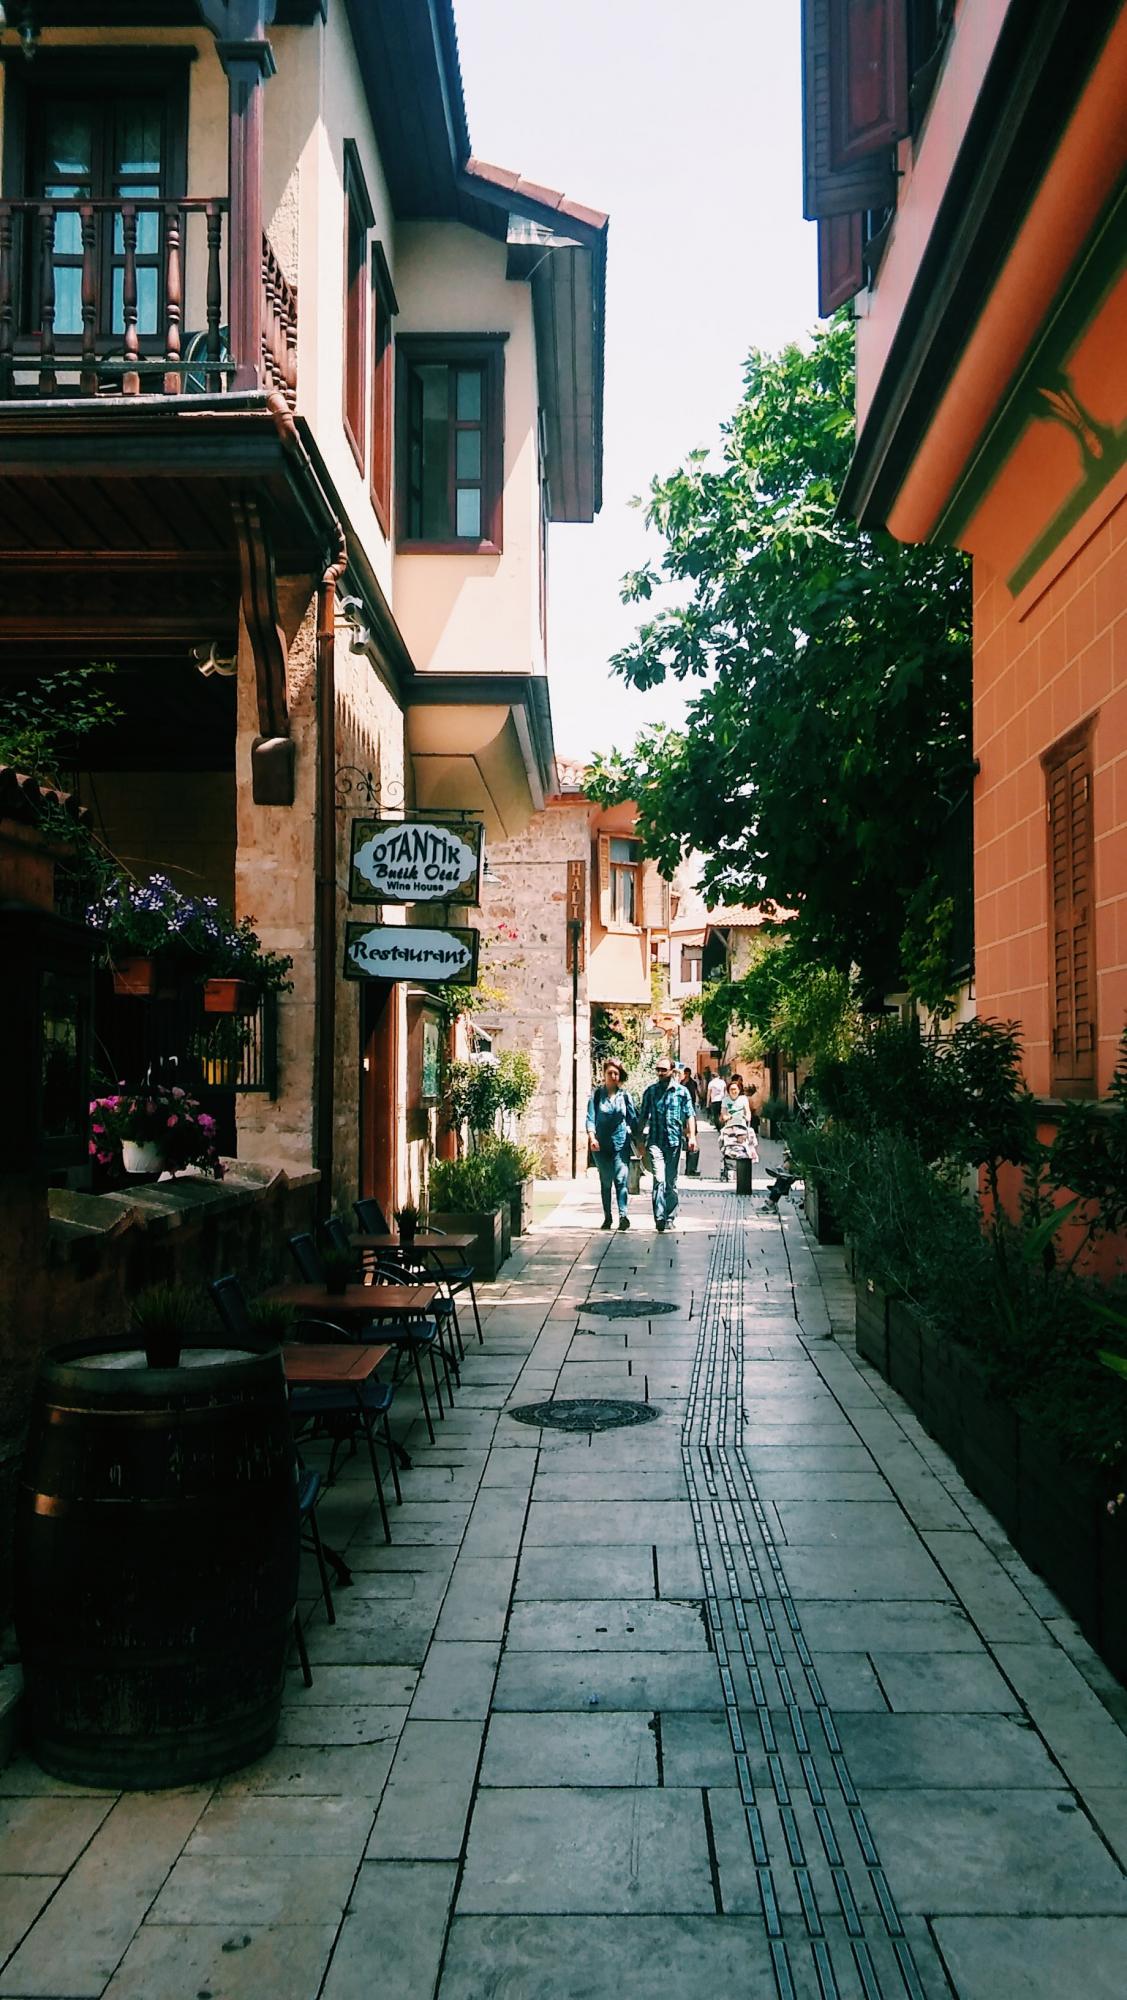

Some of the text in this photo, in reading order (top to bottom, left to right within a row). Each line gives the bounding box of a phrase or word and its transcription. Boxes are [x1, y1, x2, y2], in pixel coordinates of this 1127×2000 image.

[373, 864, 460, 881] Butik Otel
[387, 881, 444, 892] Wine House
[353, 941, 467, 964] Restaurant
